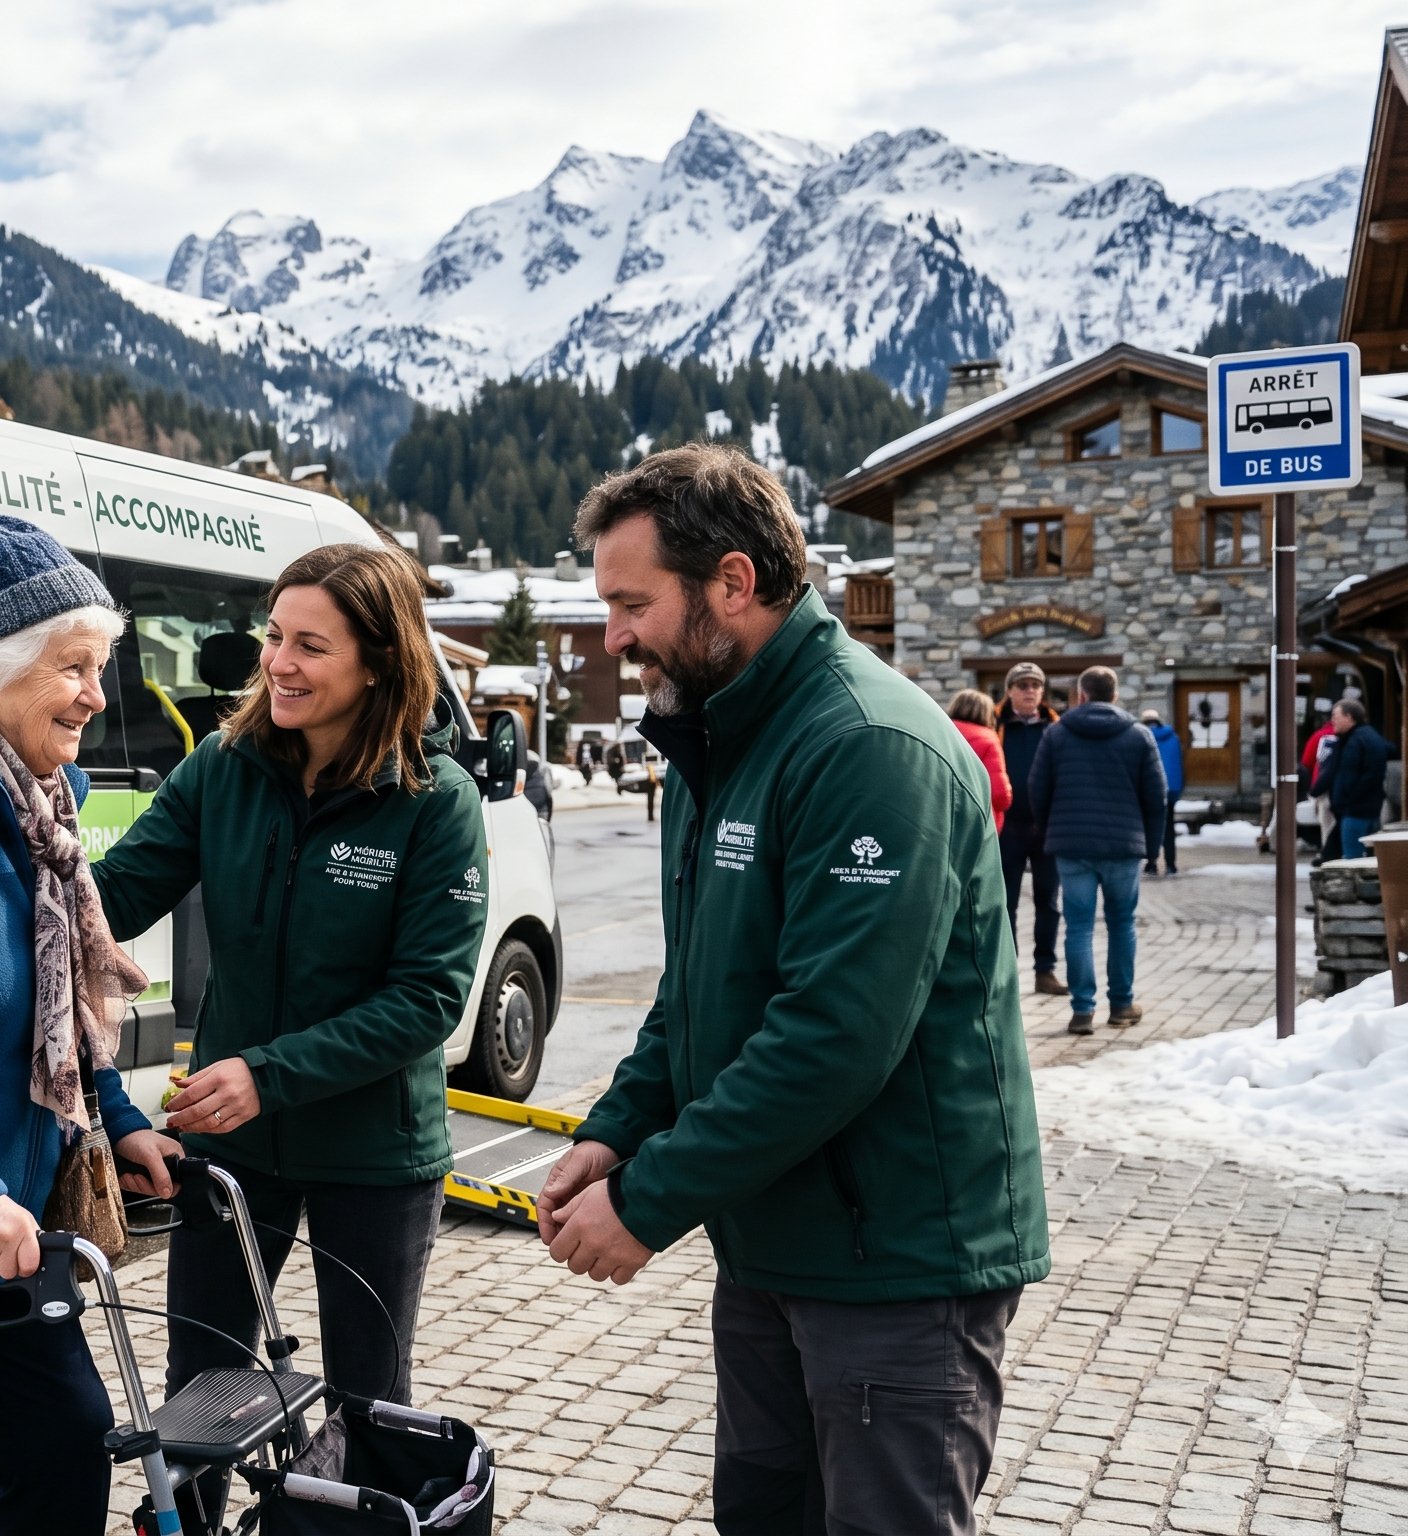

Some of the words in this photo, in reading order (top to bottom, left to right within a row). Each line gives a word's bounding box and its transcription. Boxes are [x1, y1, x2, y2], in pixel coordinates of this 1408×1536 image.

[1245, 458, 1272, 477] DE
[1281, 455, 1322, 474] BUS
[96, 490, 265, 553] ACCOMPAGNÉ
